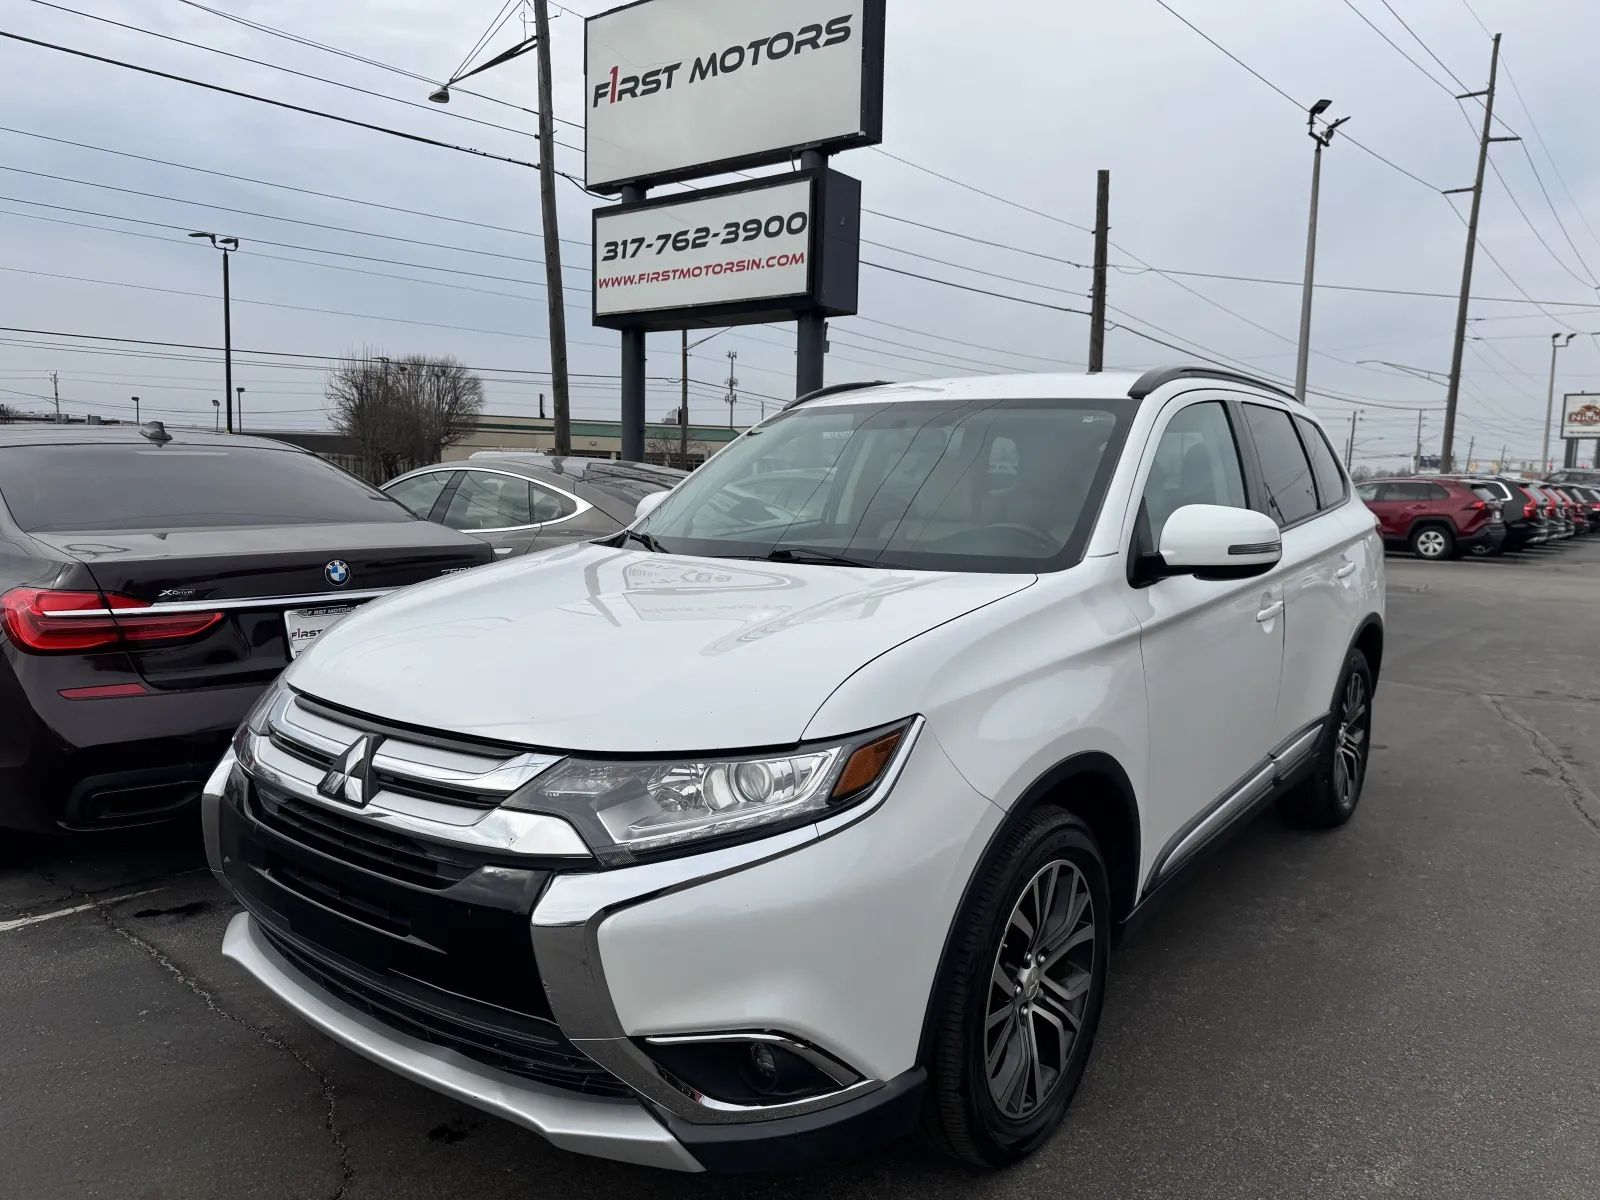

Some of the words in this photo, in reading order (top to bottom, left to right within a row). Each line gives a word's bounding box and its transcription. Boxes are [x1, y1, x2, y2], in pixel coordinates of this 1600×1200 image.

[688, 13, 853, 84] MOTORS
[601, 211, 808, 262] 317-762-3900
[598, 252, 805, 289] WWW.FIRSTMOTORSIN.COM
